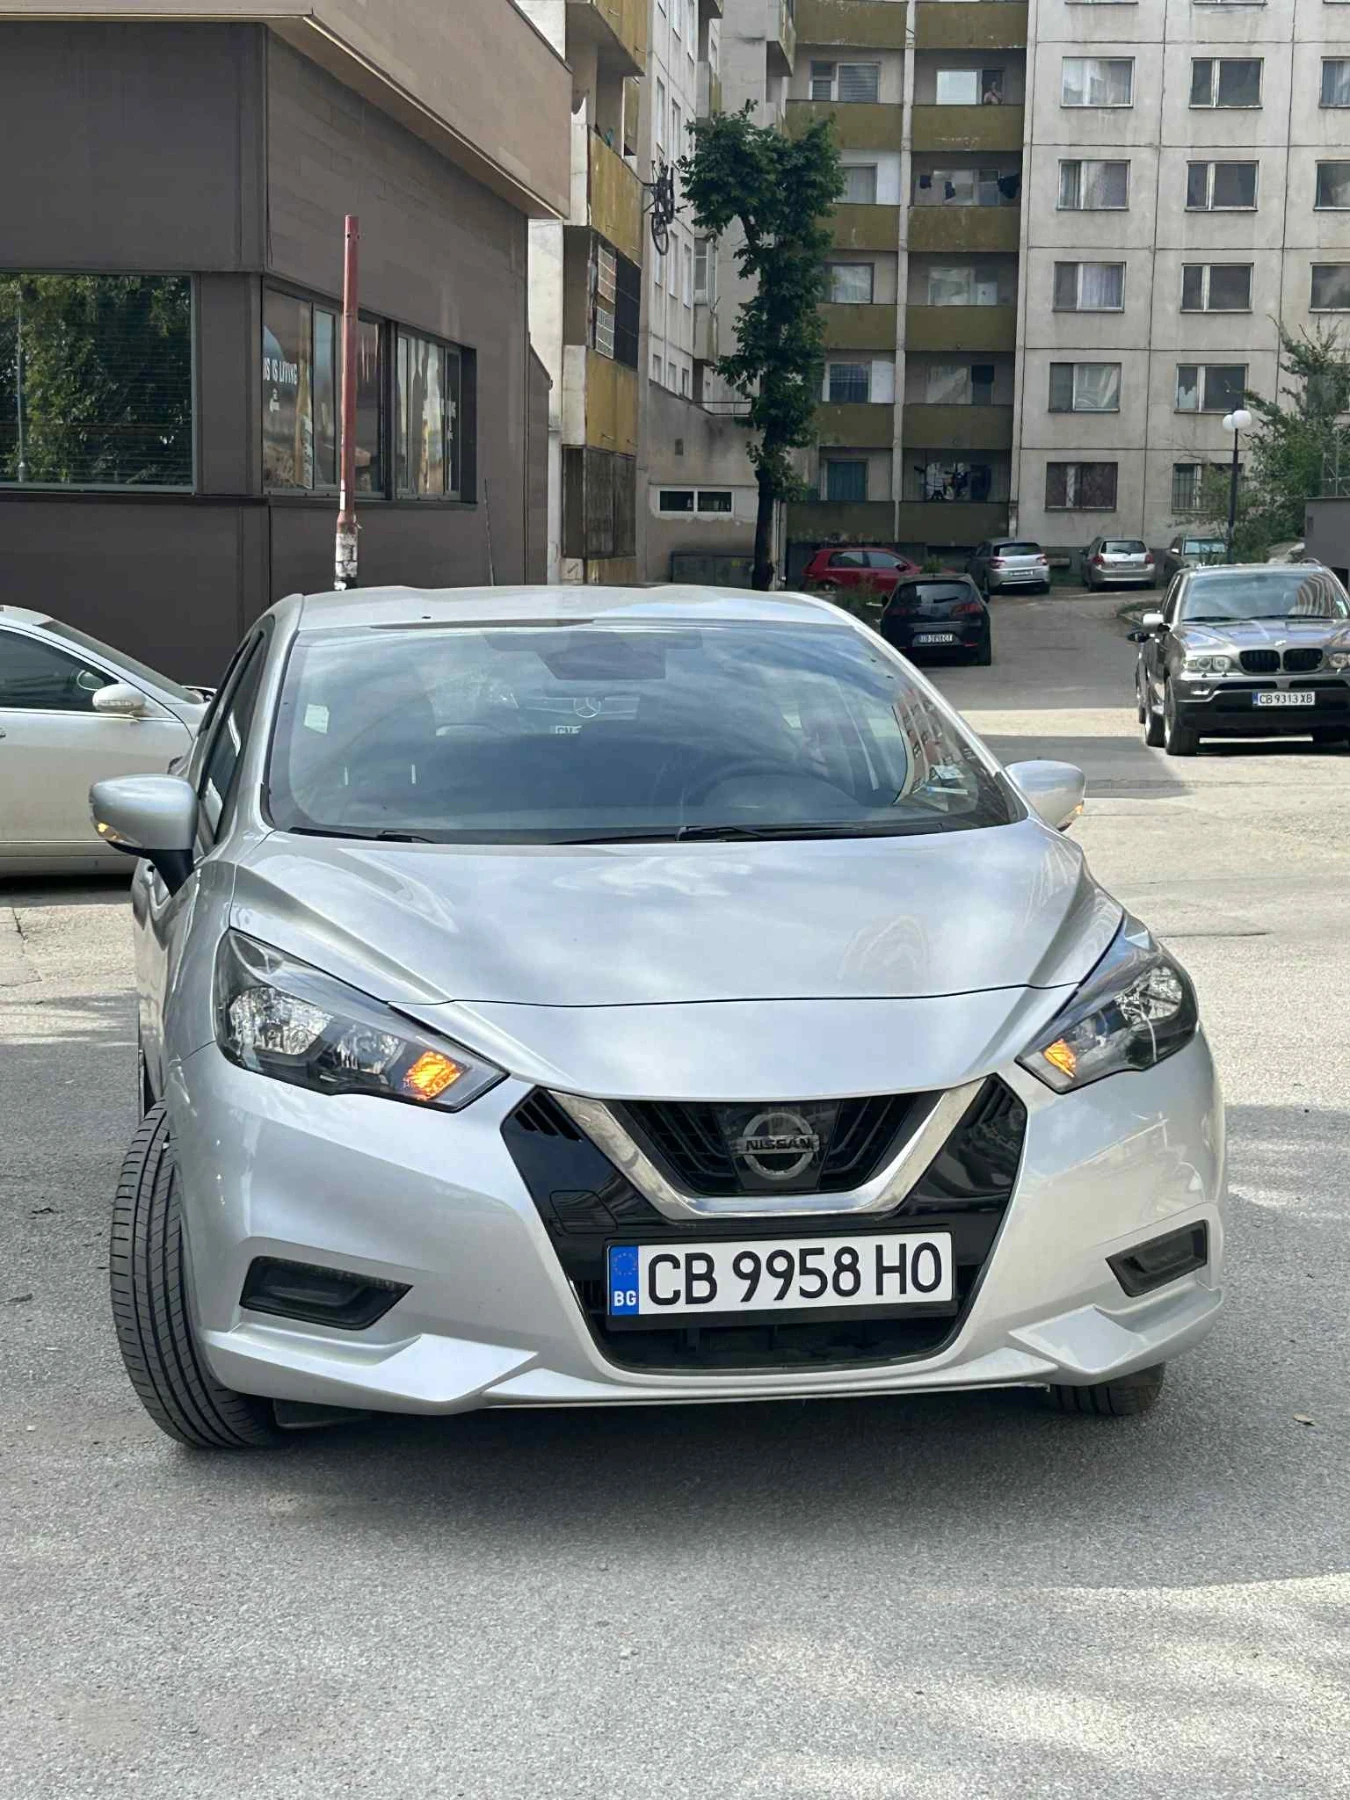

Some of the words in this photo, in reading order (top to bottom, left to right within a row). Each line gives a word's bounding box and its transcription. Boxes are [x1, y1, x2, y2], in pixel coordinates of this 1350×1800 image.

[1260, 694, 1272, 704] CB
[1274, 694, 1298, 704] 9313
[746, 1138, 814, 1151] NISSAN
[648, 1252, 718, 1306] CB
[732, 1246, 862, 1302] 9958
[875, 1242, 943, 1297] HO
[614, 1290, 637, 1306] BG
